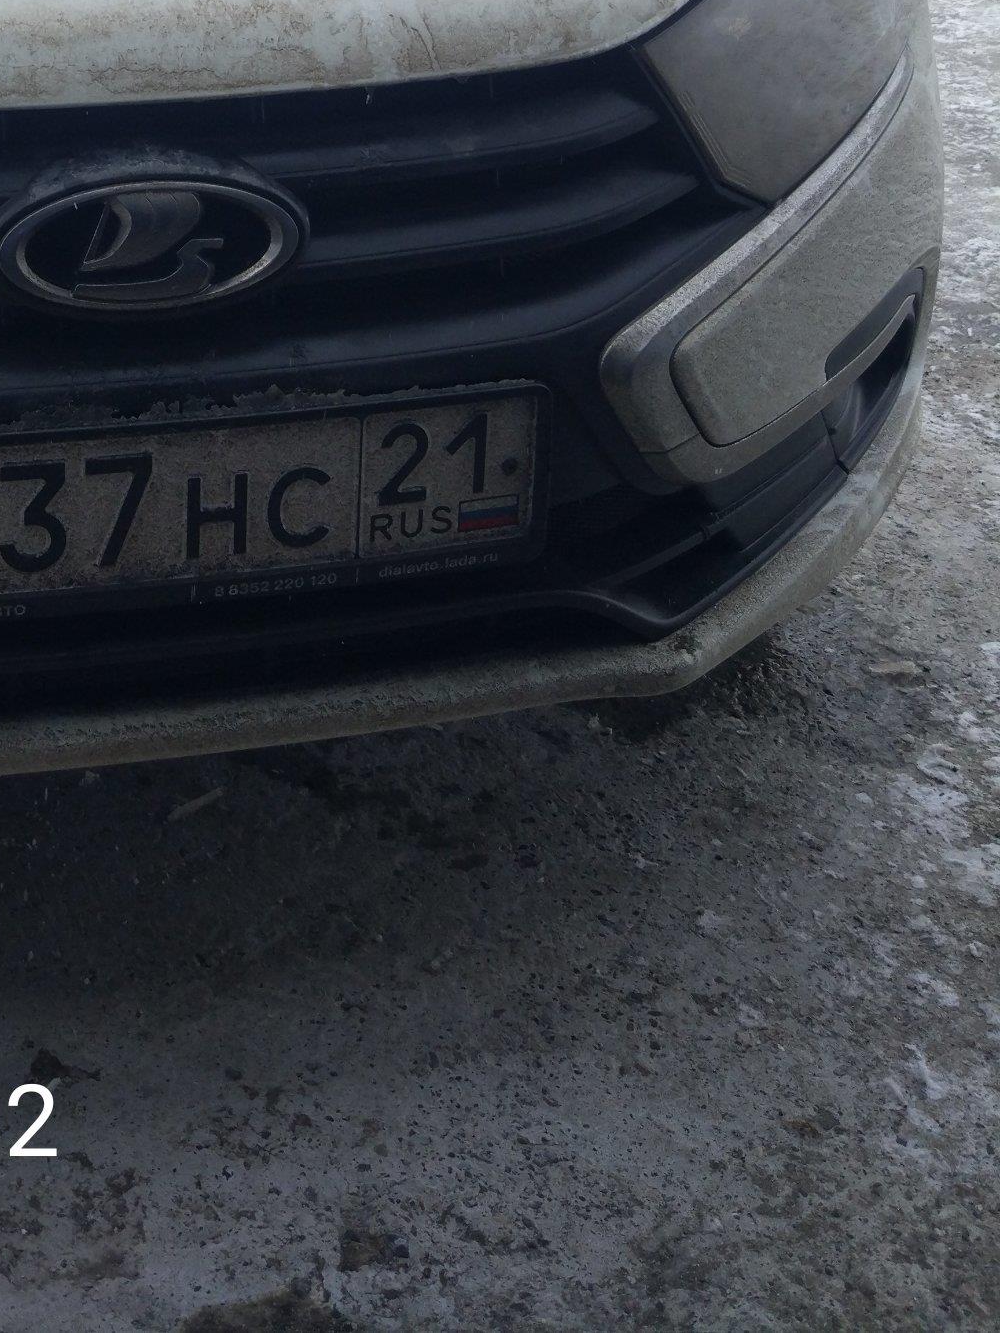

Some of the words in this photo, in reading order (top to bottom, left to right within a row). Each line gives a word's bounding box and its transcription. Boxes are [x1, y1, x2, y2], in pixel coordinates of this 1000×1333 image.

[377, 413, 489, 507] 21
[369, 505, 453, 543] RUS
[273, 576, 305, 592] 220
[310, 572, 337, 587] 120
